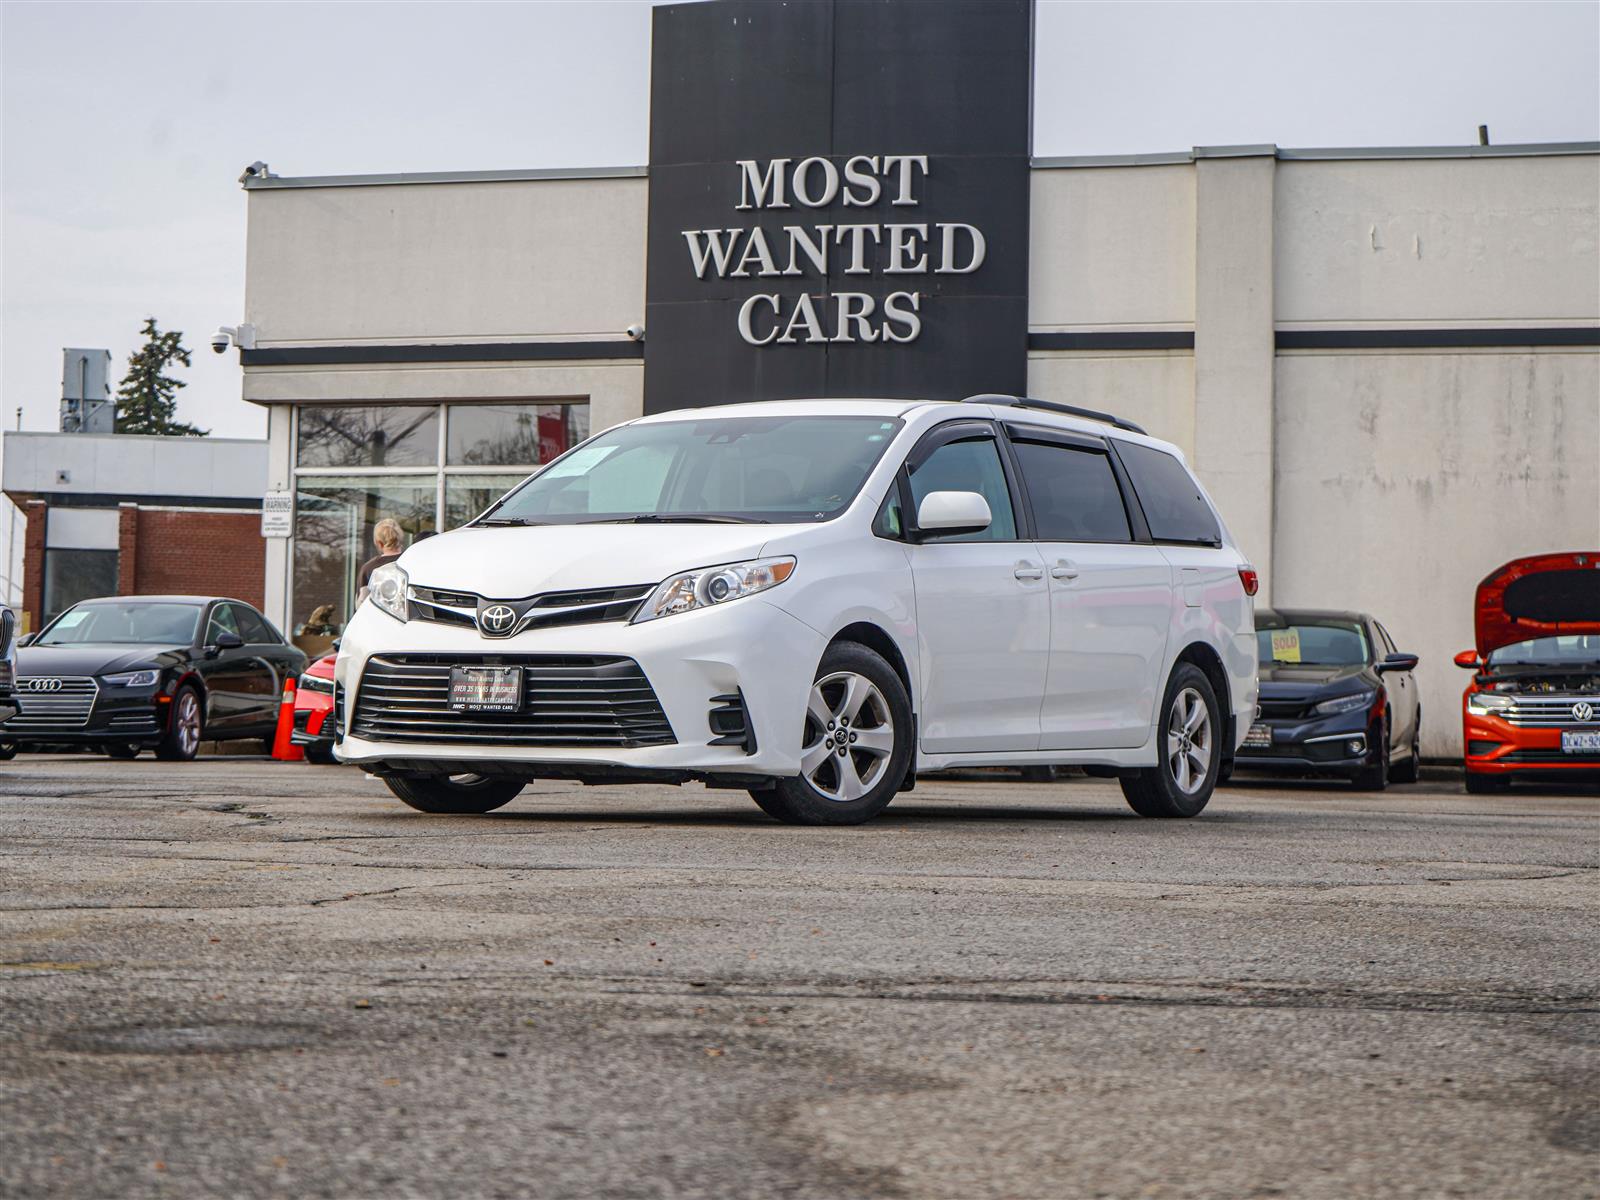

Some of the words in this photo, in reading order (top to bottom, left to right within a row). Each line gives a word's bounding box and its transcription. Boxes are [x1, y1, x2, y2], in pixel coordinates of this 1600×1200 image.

[735, 155, 930, 210] MOST
[682, 223, 987, 279] WANTED
[737, 291, 922, 346] CARS
[265, 500, 292, 510] WARNING
[1273, 636, 1297, 650] SOLD
